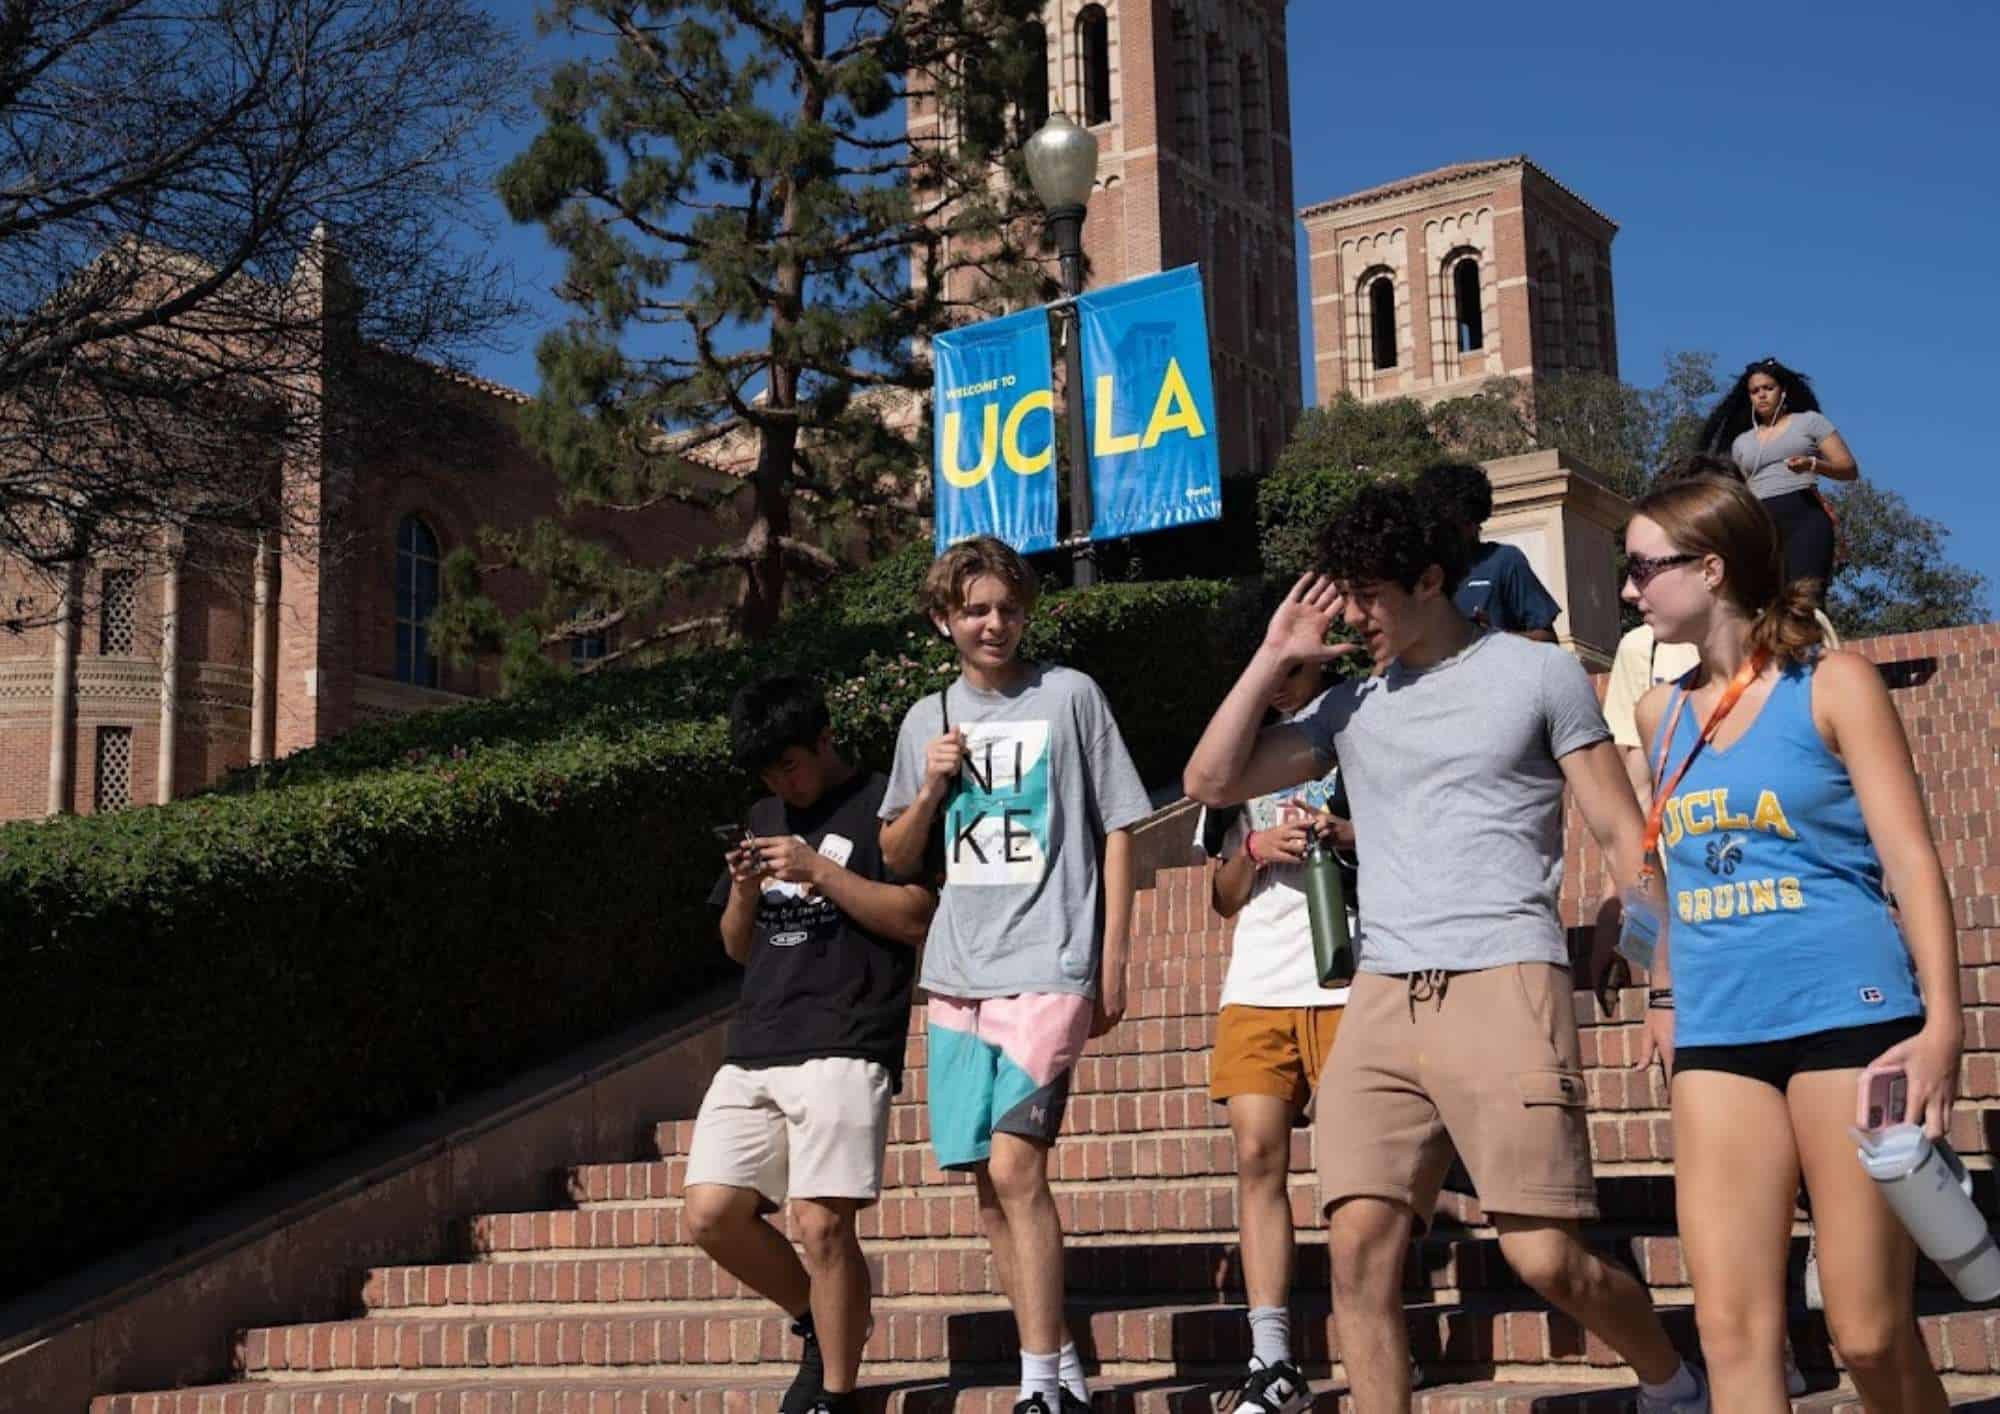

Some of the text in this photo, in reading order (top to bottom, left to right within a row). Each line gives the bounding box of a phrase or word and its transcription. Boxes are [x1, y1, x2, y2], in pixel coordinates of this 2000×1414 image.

[1001, 375, 1017, 388] TO
[953, 809, 1033, 865] KE
[1677, 876, 1806, 925] BRUINS
